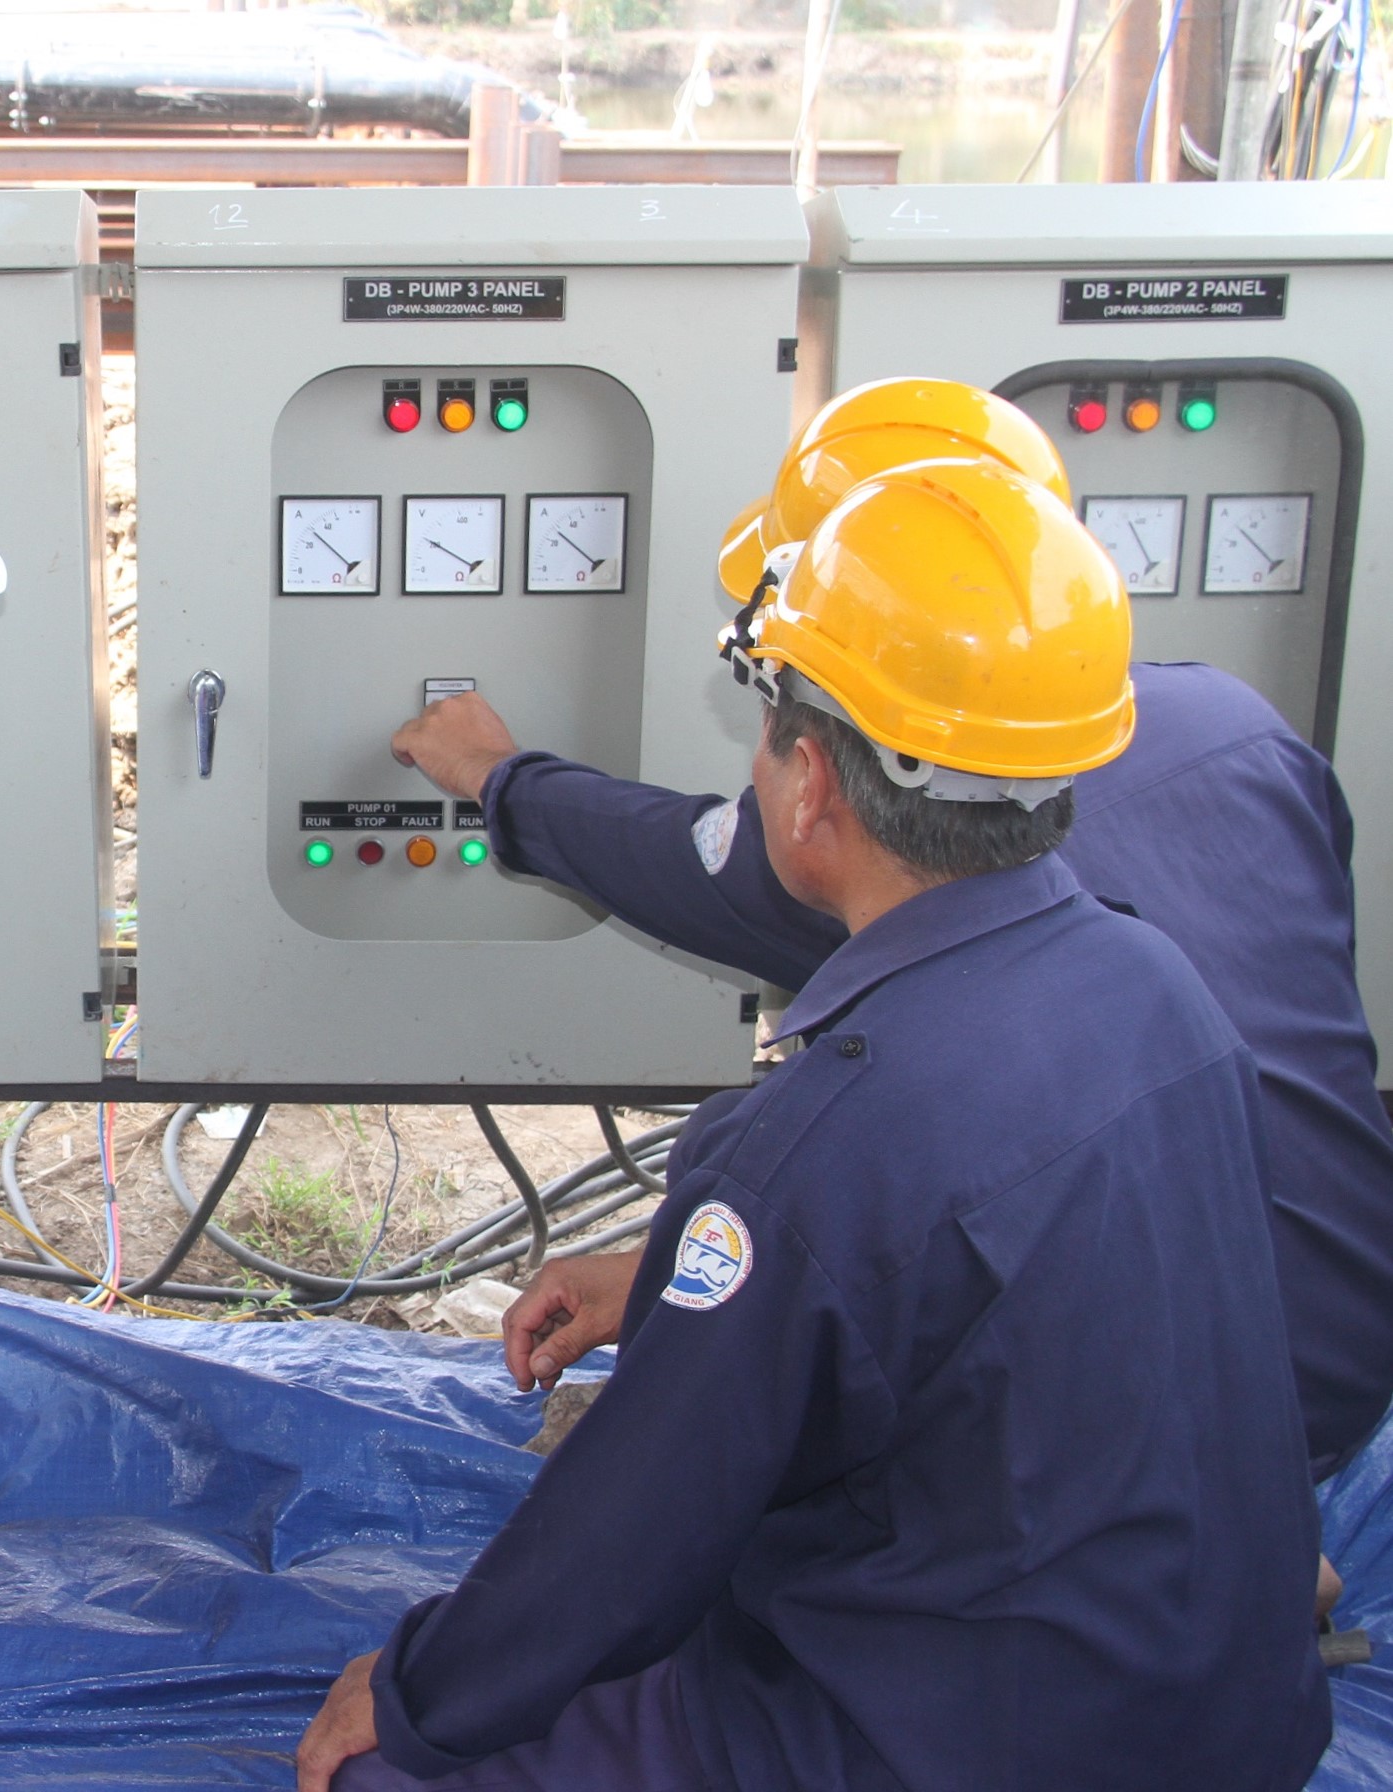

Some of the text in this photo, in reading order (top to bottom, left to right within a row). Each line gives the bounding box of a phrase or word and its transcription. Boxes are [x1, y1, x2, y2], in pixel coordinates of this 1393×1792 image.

[209, 204, 248, 224] 12
[641, 200, 659, 216] 3
[890, 199, 938, 224] 4
[364, 282, 391, 298] DB
[408, 282, 462, 297] PUMP
[467, 282, 478, 297] 3
[484, 282, 544, 296] PANEL
[1082, 283, 1110, 299] DB
[1126, 282, 1182, 298] PUMP
[1186, 282, 1197, 297] 2
[1202, 280, 1266, 296] PANEL
[492, 303, 523, 315] 50HZ)
[1210, 303, 1242, 315] 50HZ)
[295, 510, 302, 518] A
[419, 509, 426, 518] V
[541, 508, 548, 516] A
[348, 804, 396, 813] PUMP 01
[306, 816, 438, 827] RUN STOP FAULT
[458, 817, 484, 826] RUN
[674, 1294, 704, 1306] GIANG
